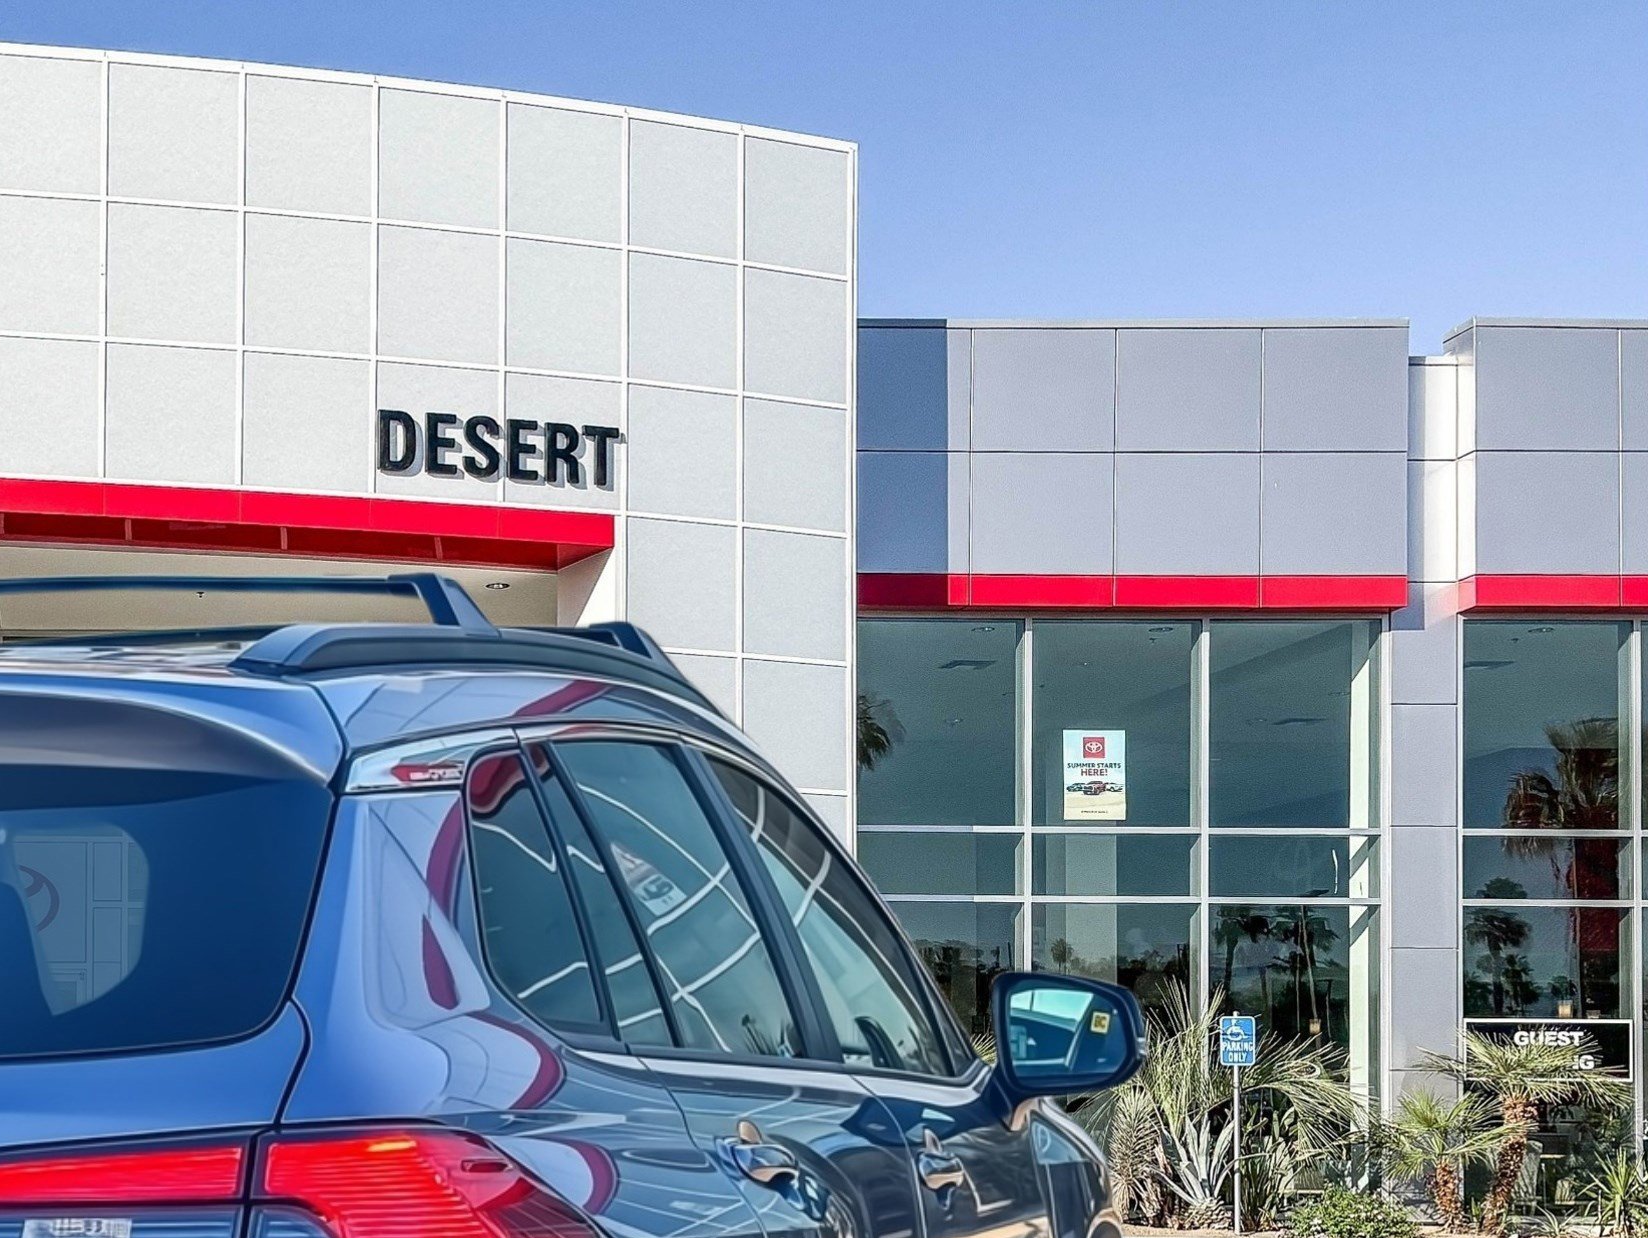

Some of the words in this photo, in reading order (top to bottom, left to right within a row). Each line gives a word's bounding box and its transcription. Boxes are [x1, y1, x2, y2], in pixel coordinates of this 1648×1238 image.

[377, 409, 620, 486] DESERT
[1080, 768, 1108, 776] HERE!
[1513, 1030, 1584, 1047] GUEST
[1222, 1040, 1253, 1052] PARKING
[1228, 1051, 1248, 1063] ONLY
